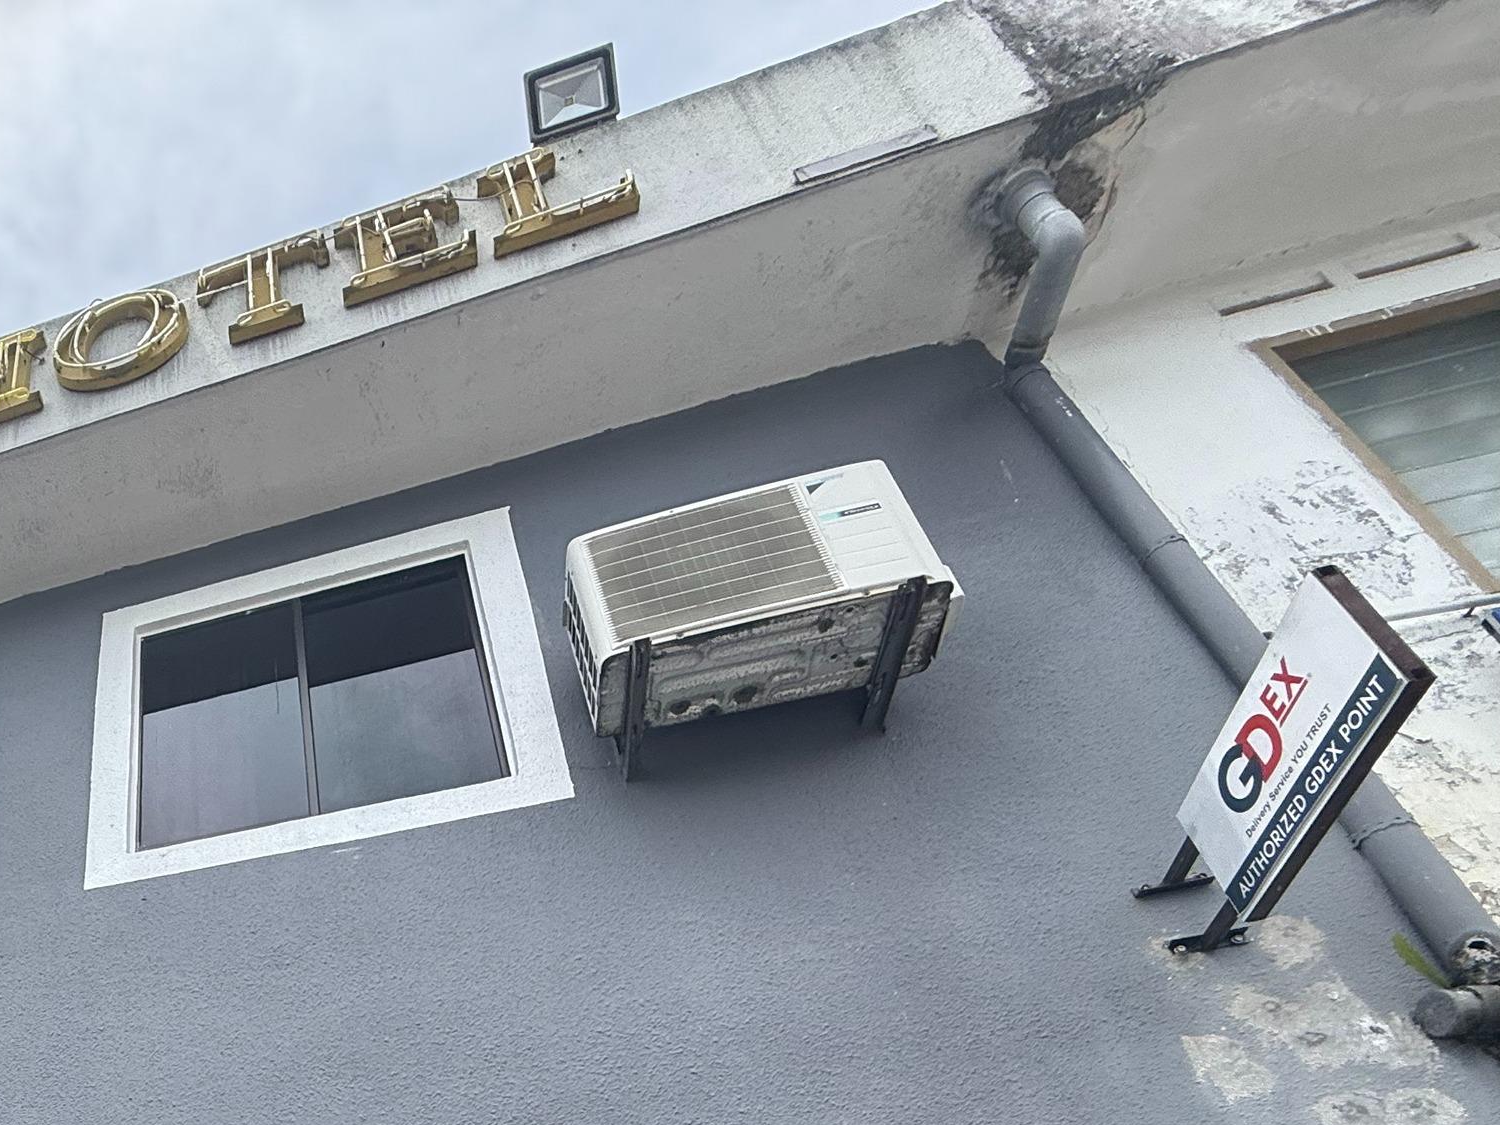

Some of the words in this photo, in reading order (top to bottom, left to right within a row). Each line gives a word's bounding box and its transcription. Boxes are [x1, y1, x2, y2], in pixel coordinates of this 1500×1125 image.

[1218, 656, 1308, 813] GDEX
[1238, 794, 1307, 899] AUTHORIZED
[1305, 740, 1344, 794] GDEX
[1338, 674, 1385, 743] POINT
[1246, 802, 1271, 838] Delivery
[1269, 765, 1294, 801] Service
[1291, 741, 1309, 765] YOU
[1306, 703, 1332, 742] TRUST
